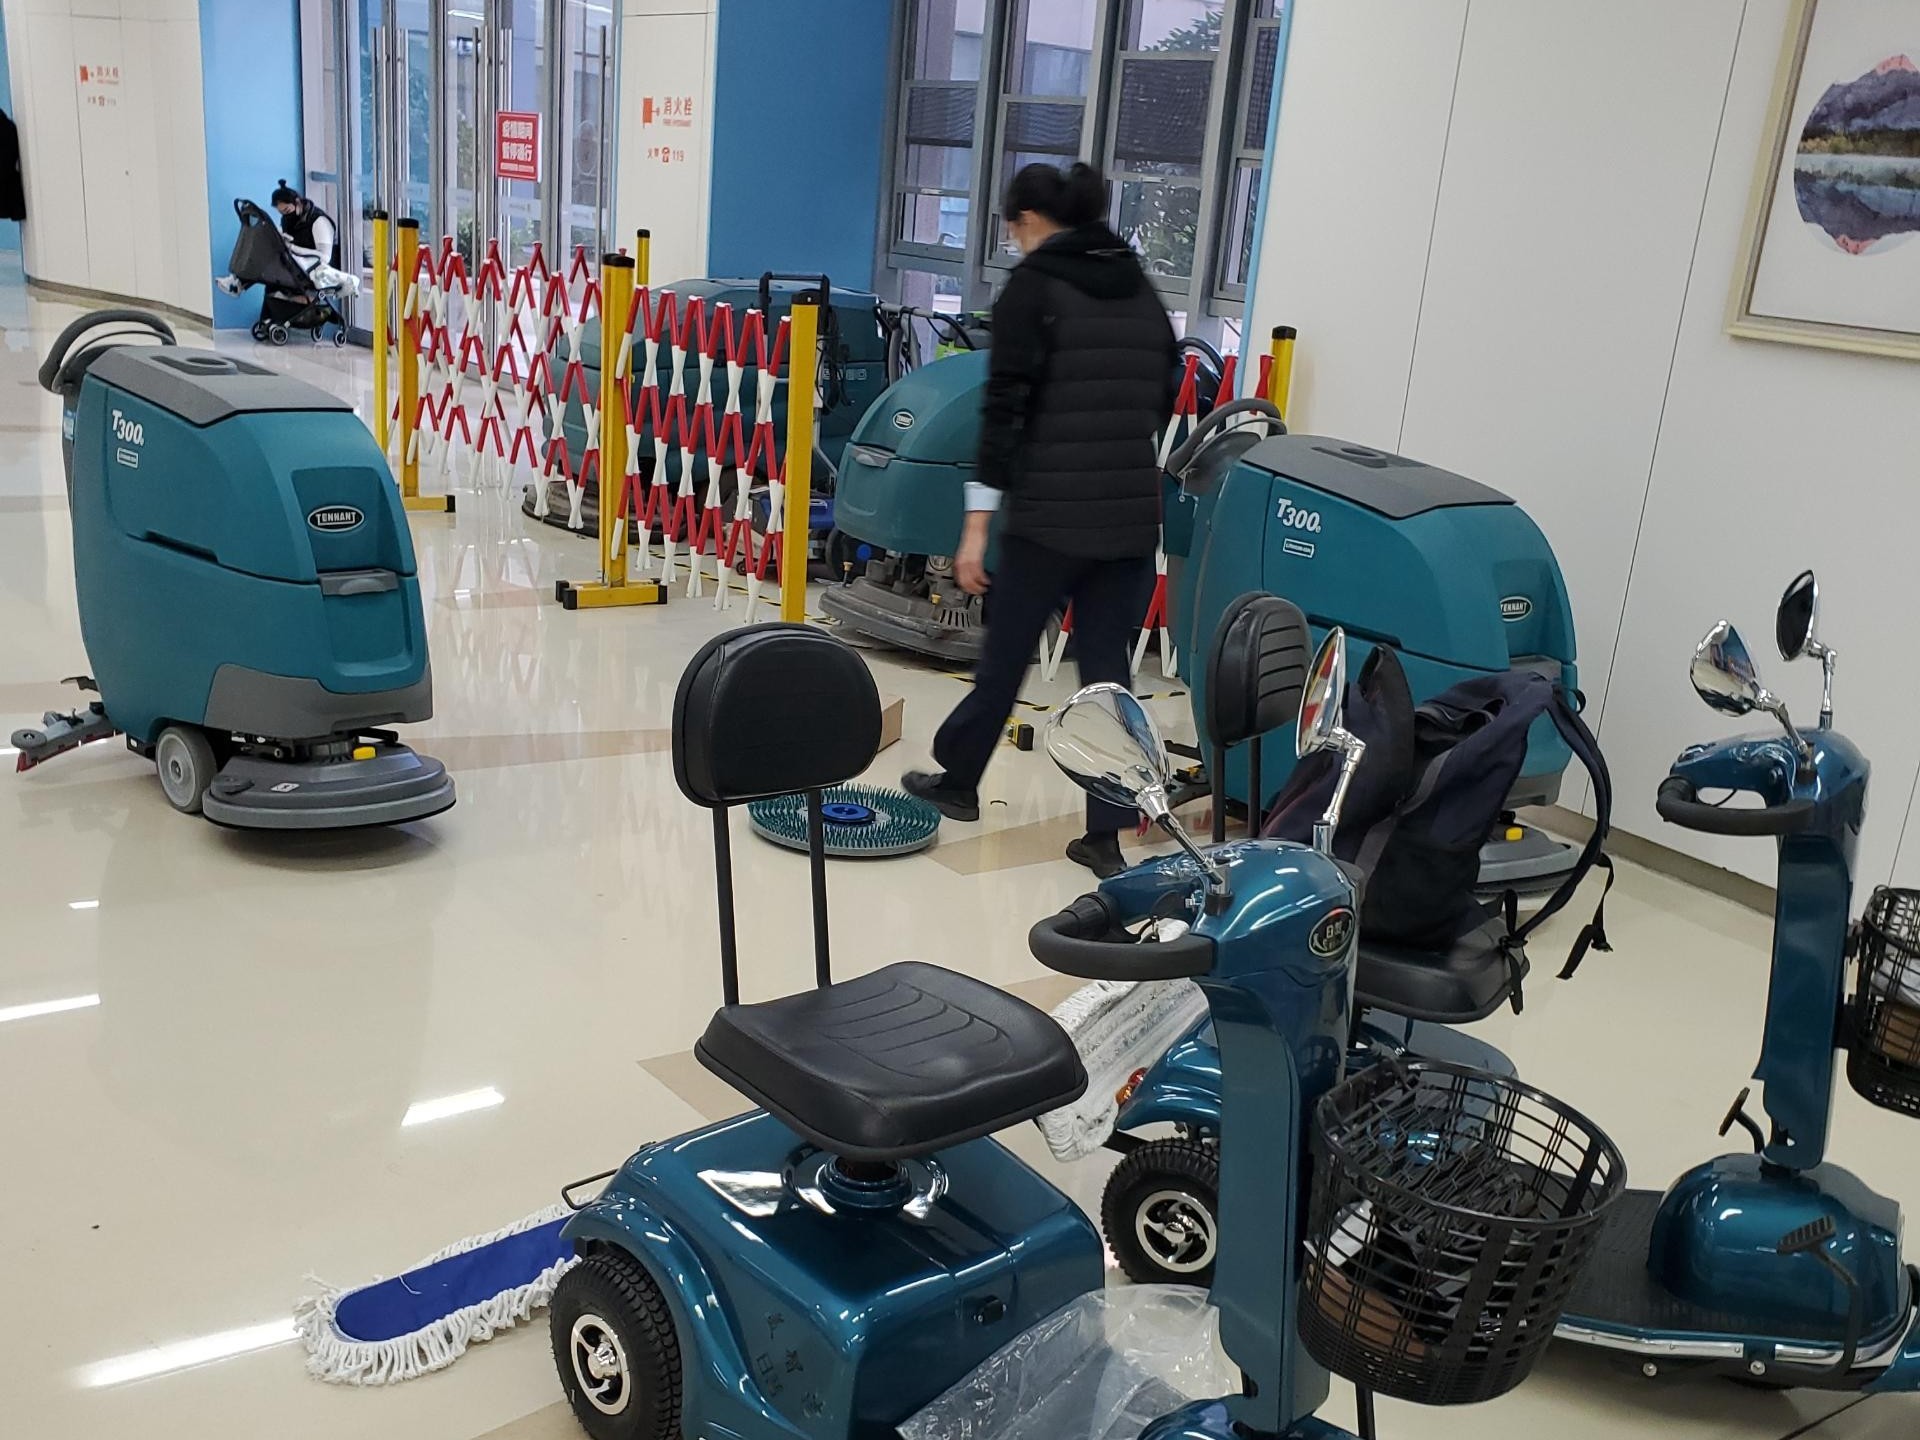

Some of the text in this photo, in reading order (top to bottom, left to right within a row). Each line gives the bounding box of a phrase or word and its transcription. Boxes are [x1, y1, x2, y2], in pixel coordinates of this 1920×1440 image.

[663, 96, 693, 116] 消火栓
[315, 511, 357, 526] TENNANT
